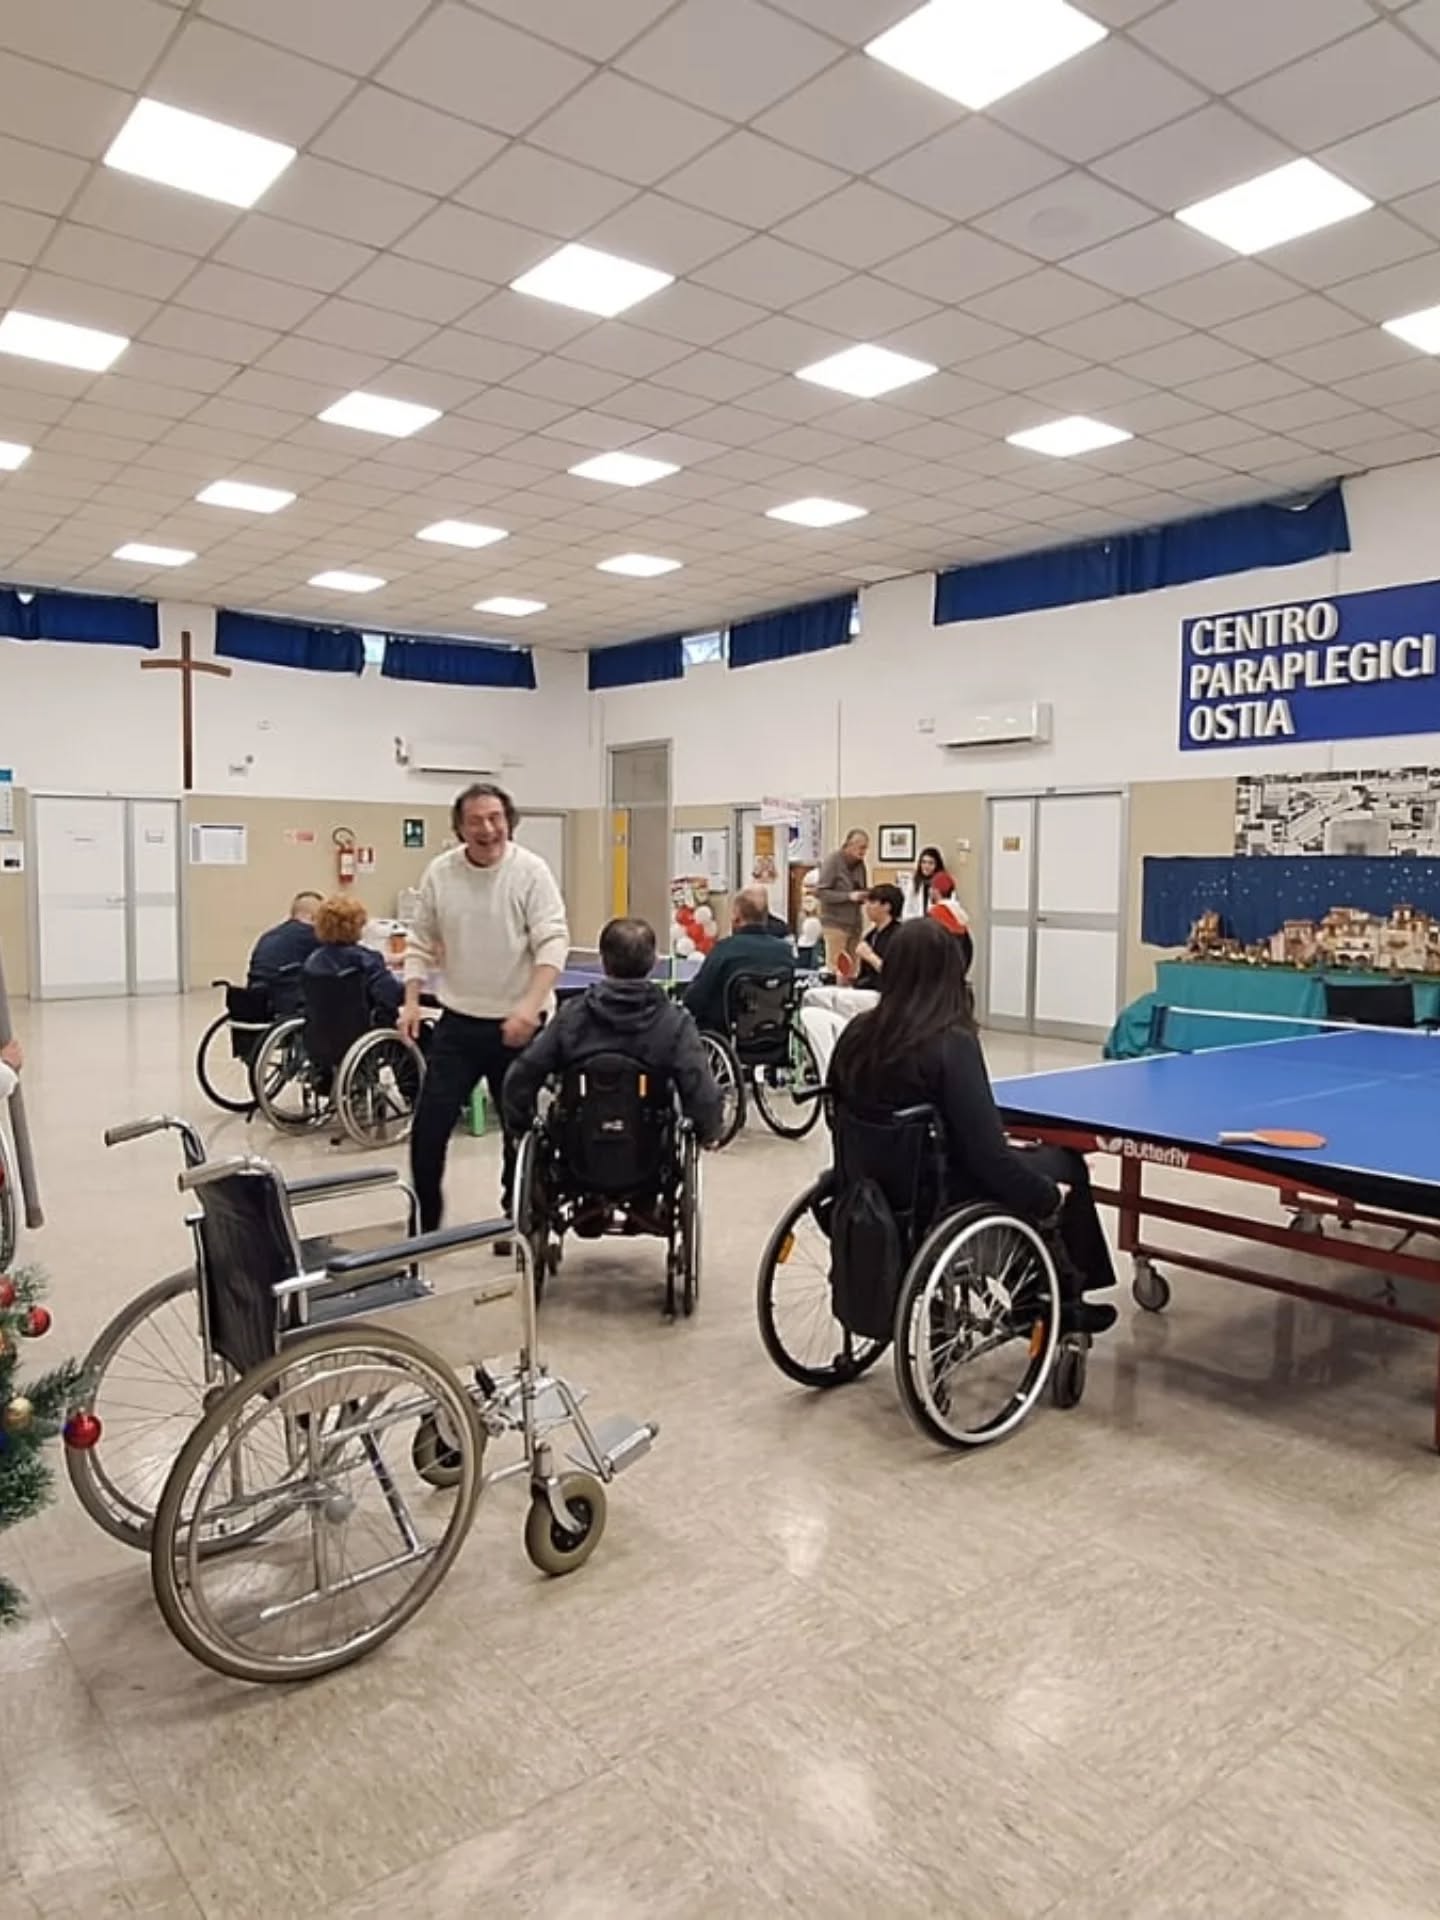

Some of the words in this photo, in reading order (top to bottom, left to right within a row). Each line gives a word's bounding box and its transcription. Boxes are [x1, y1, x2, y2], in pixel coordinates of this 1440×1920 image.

[1190, 602, 1338, 656] CENTRO
[1189, 633, 1436, 700] PARAPLEGICI
[1189, 698, 1295, 741] OSTIA
[1124, 1138, 1189, 1168] Butterfly
